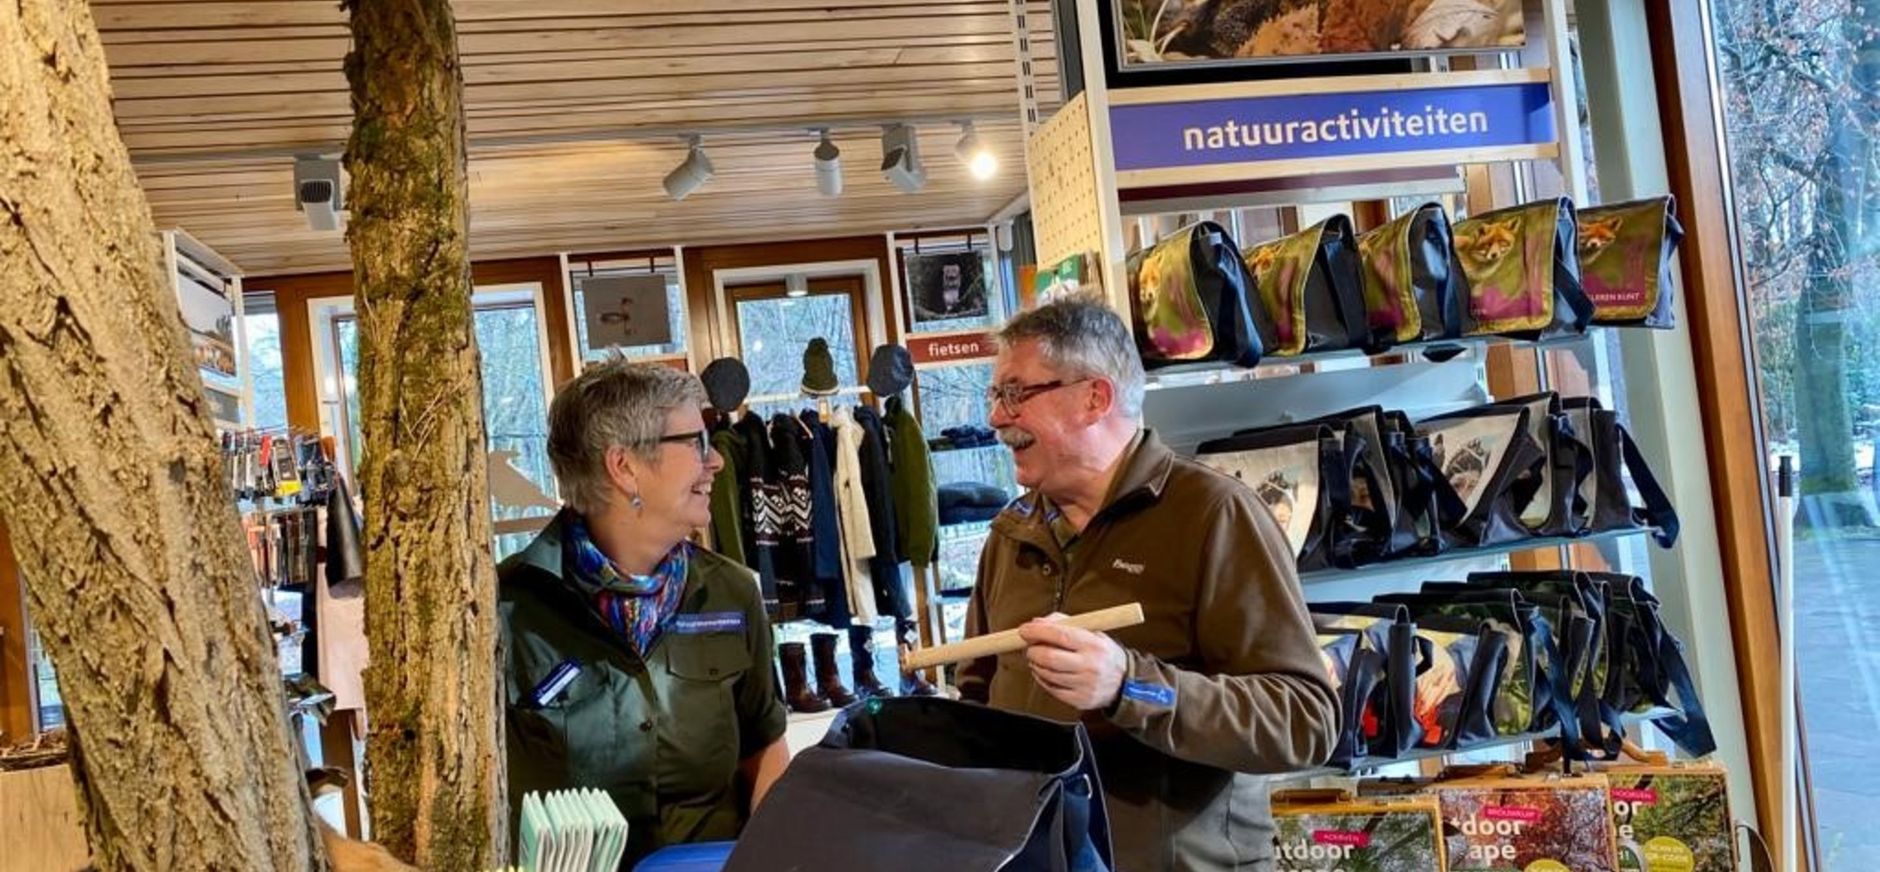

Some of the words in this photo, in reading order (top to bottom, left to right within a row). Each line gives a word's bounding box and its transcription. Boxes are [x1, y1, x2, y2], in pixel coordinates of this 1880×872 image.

[1183, 103, 1488, 151] natuuractiviteiten
[928, 341, 980, 357] fietsen
[1450, 813, 1526, 836] tdoor
[1468, 844, 1517, 867] ape
